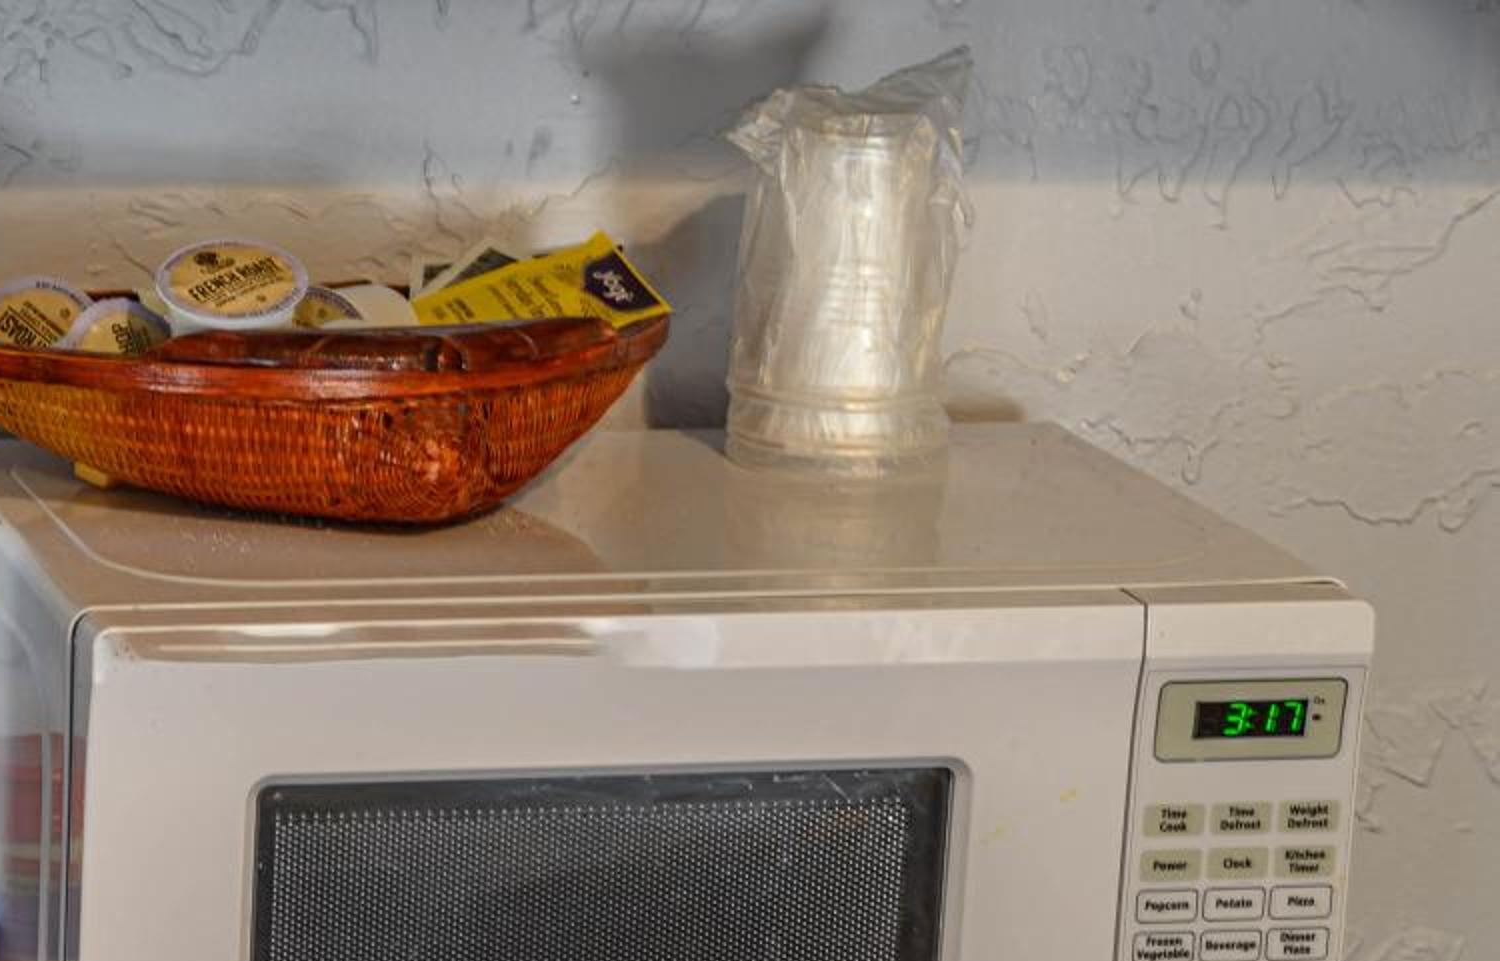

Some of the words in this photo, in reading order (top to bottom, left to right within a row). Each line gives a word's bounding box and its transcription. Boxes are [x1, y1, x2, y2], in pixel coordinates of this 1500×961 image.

[1222, 701, 1305, 736] 3:17
[1161, 808, 1187, 819] Time
[1229, 806, 1255, 816] Time
[1289, 804, 1329, 817] Weight
[1159, 822, 1187, 832] Cook
[1220, 820, 1261, 831] Defrost
[1287, 817, 1328, 829] Defrost
[1153, 861, 1187, 871] Power
[1223, 858, 1252, 870] Clock
[1144, 900, 1190, 912] Popcorn
[1215, 898, 1253, 909] Potato
[1287, 896, 1315, 906] Pizza
[1205, 940, 1256, 951] Beverage
[1136, 947, 1190, 961] Vegetable
